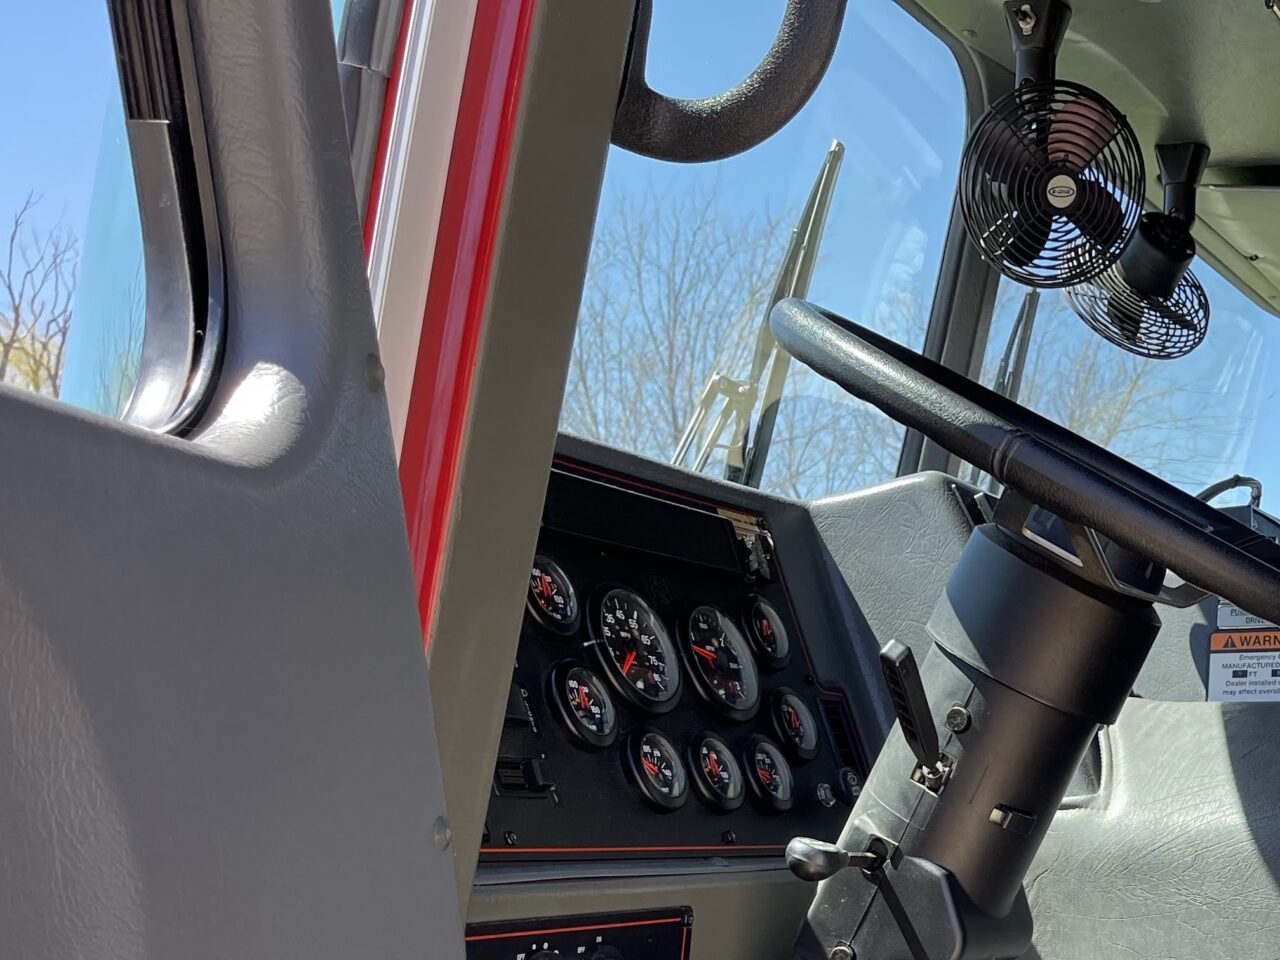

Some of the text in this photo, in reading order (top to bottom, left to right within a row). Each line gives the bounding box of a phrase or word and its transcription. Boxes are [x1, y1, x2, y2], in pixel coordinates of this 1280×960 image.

[605, 613, 615, 623] 35
[616, 610, 625, 620] 45
[629, 619, 638, 628] 55
[641, 635, 651, 645] 65
[648, 656, 658, 665] 75
